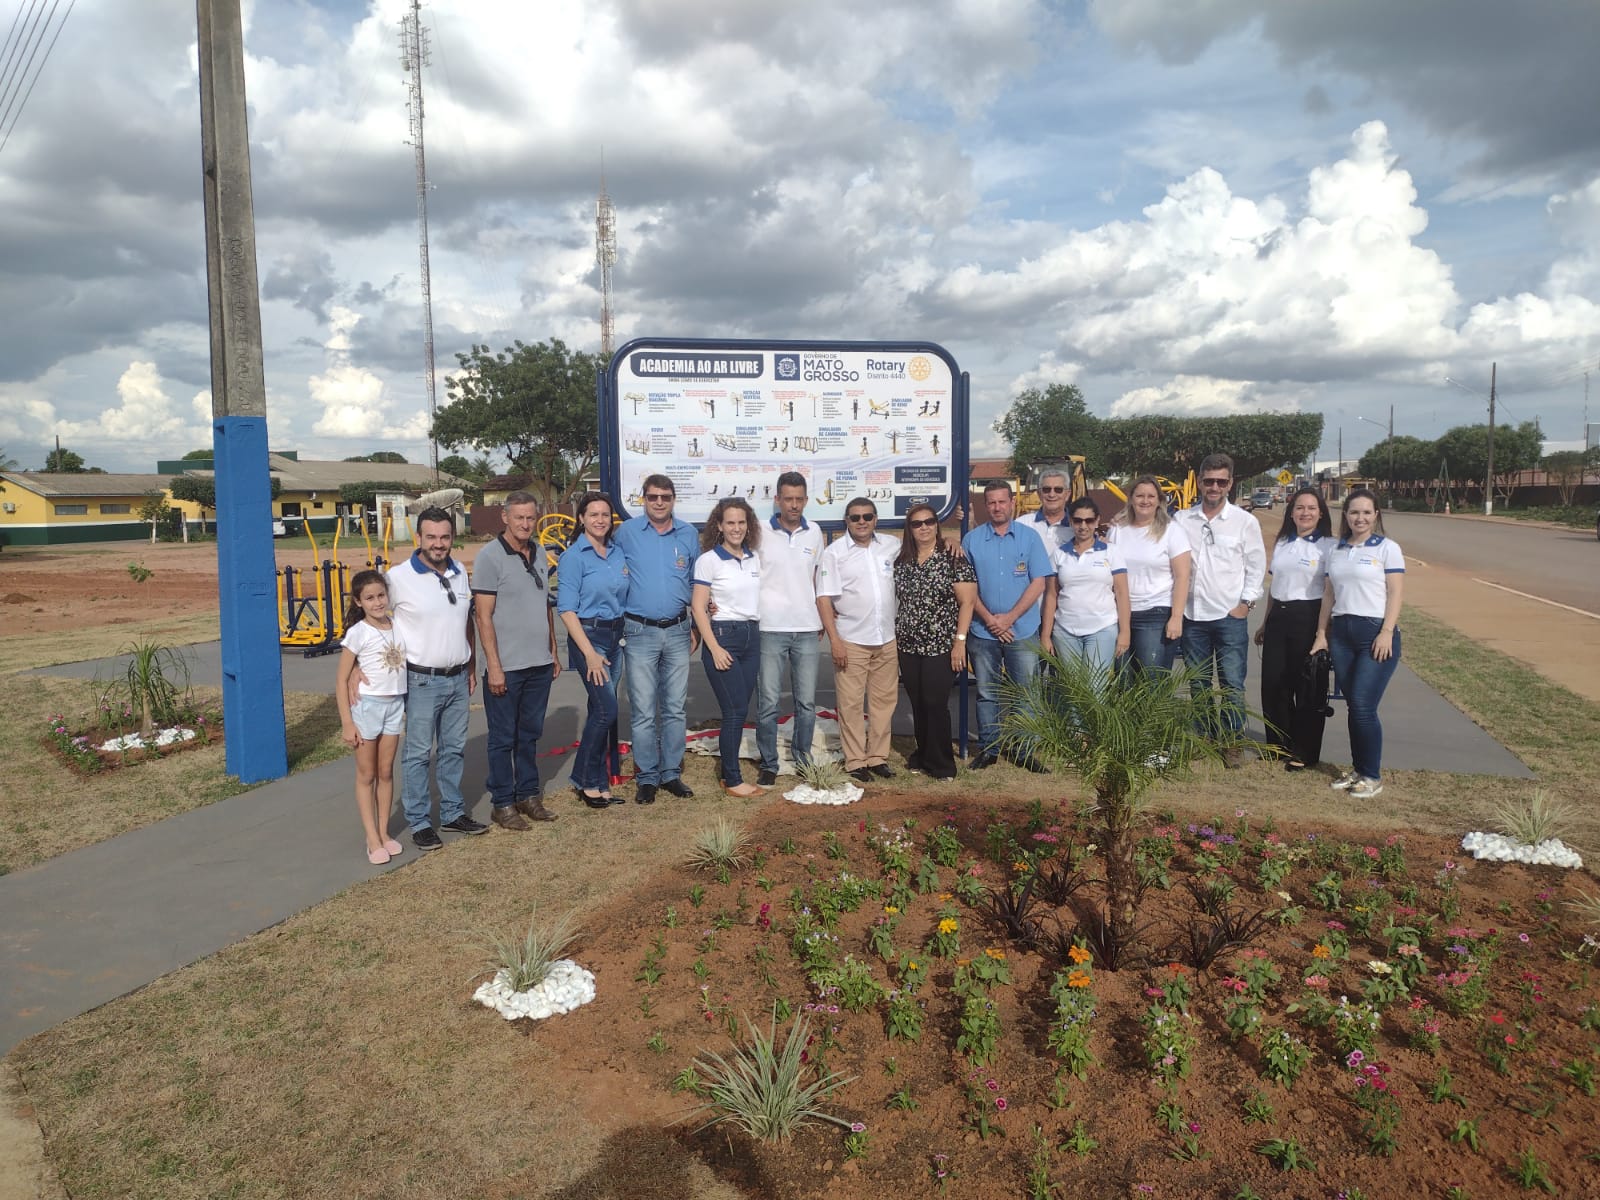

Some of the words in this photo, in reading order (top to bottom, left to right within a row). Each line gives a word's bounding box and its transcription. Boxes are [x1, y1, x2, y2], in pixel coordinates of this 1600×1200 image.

[640, 359, 695, 373] ACADEMIA
[697, 360, 711, 374] AO
[713, 360, 728, 374] AR
[730, 361, 759, 374] LIVRE
[803, 359, 844, 371] MATO
[866, 358, 906, 373] Rotary
[803, 370, 860, 382] GROSSO
[866, 372, 888, 380] Distrito
